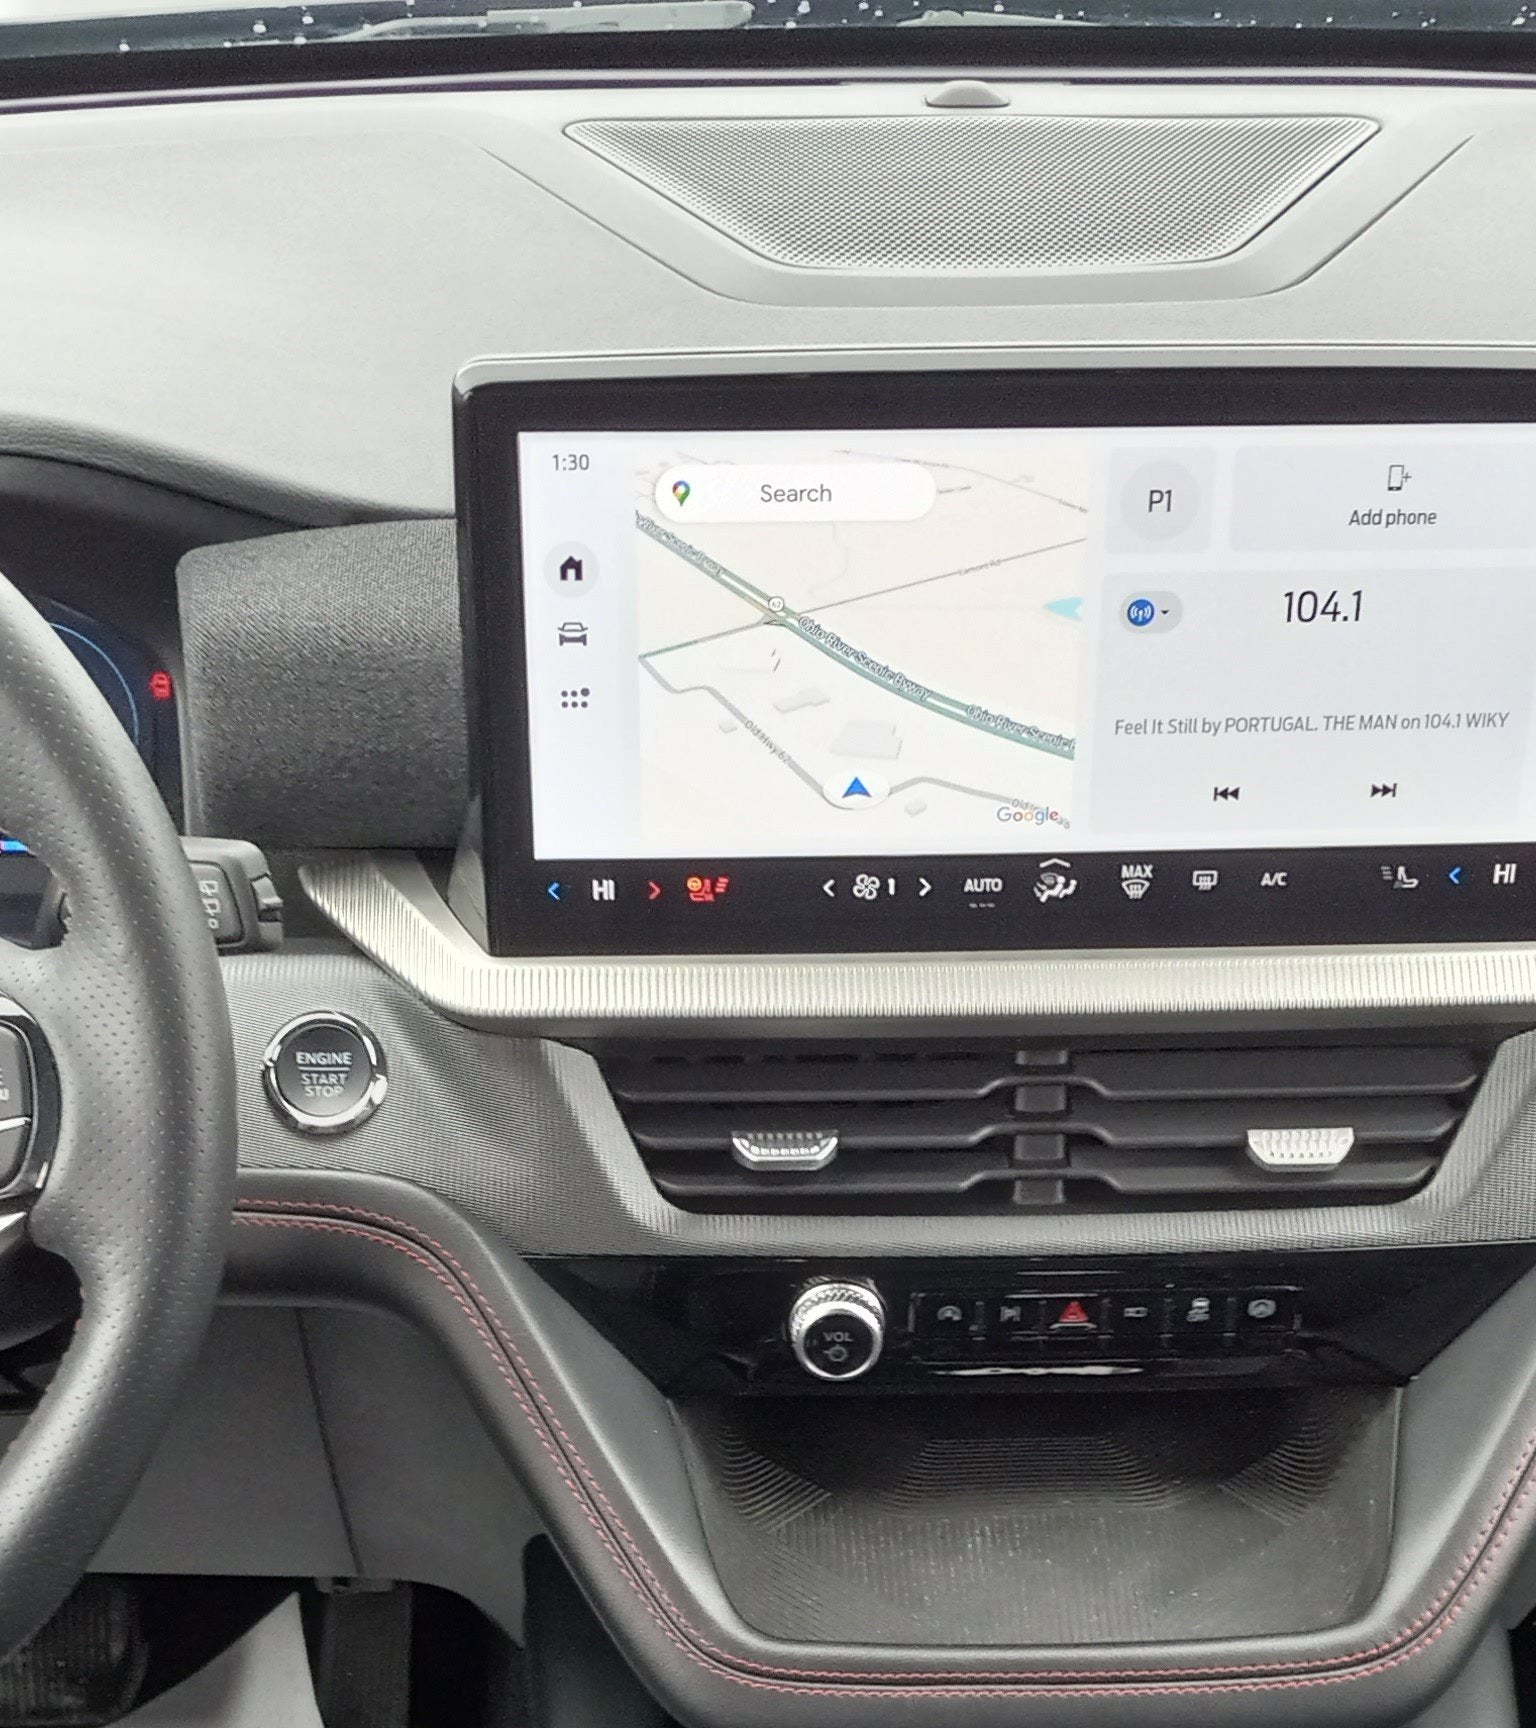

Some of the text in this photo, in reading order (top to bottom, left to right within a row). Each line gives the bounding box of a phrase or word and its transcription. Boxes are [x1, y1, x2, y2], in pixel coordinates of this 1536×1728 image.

[552, 454, 590, 472] 1:30
[760, 483, 833, 504] Search
[1148, 488, 1173, 513] P1
[1349, 508, 1437, 529] Add phone
[1283, 590, 1364, 624] 104.1
[1115, 712, 1510, 737] Feel It Still by PORTUGAL. THE MAN on 104.1 WIKY
[996, 806, 1059, 826] Google
[1121, 864, 1154, 878] MAX
[1261, 872, 1288, 887] A/C
[1492, 864, 1517, 884] HI
[592, 879, 615, 900] HI
[964, 877, 1003, 892] AUTO
[296, 1051, 353, 1066] ENGINE
[300, 1073, 348, 1086] START
[304, 1085, 344, 1098] STOP
[823, 1332, 854, 1342] VOL
